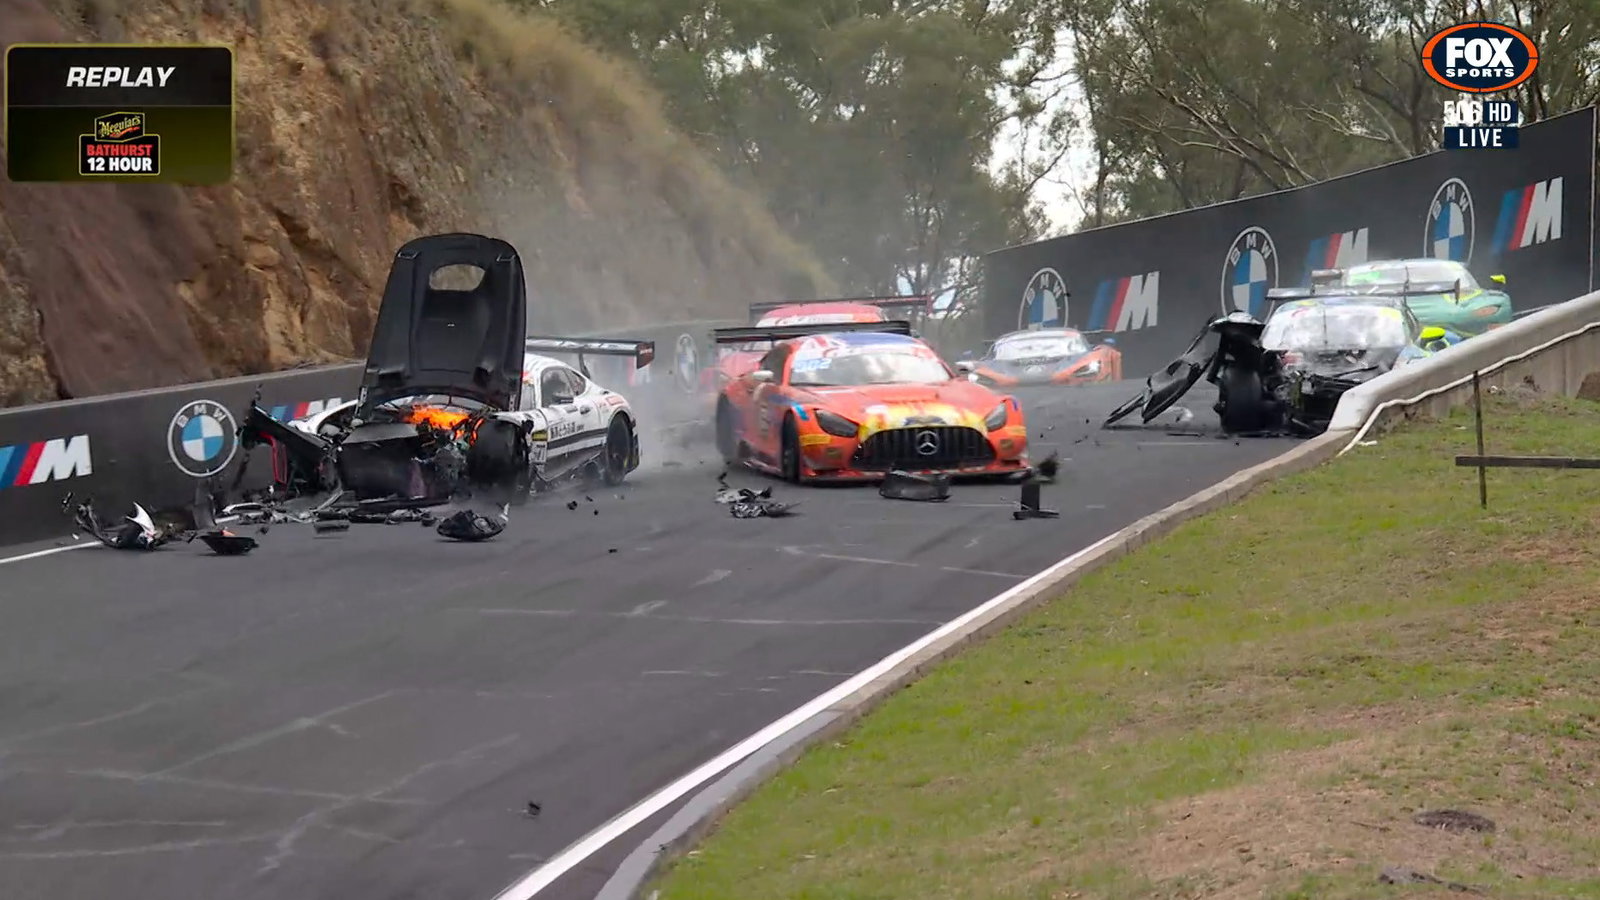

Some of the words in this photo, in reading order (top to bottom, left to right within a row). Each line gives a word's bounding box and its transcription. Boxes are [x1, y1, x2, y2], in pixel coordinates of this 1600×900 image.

[1432, 183, 1470, 221] BMW
[1230, 232, 1272, 266] BMW
[1026, 272, 1063, 305] BMW
[176, 404, 227, 428] BMW
